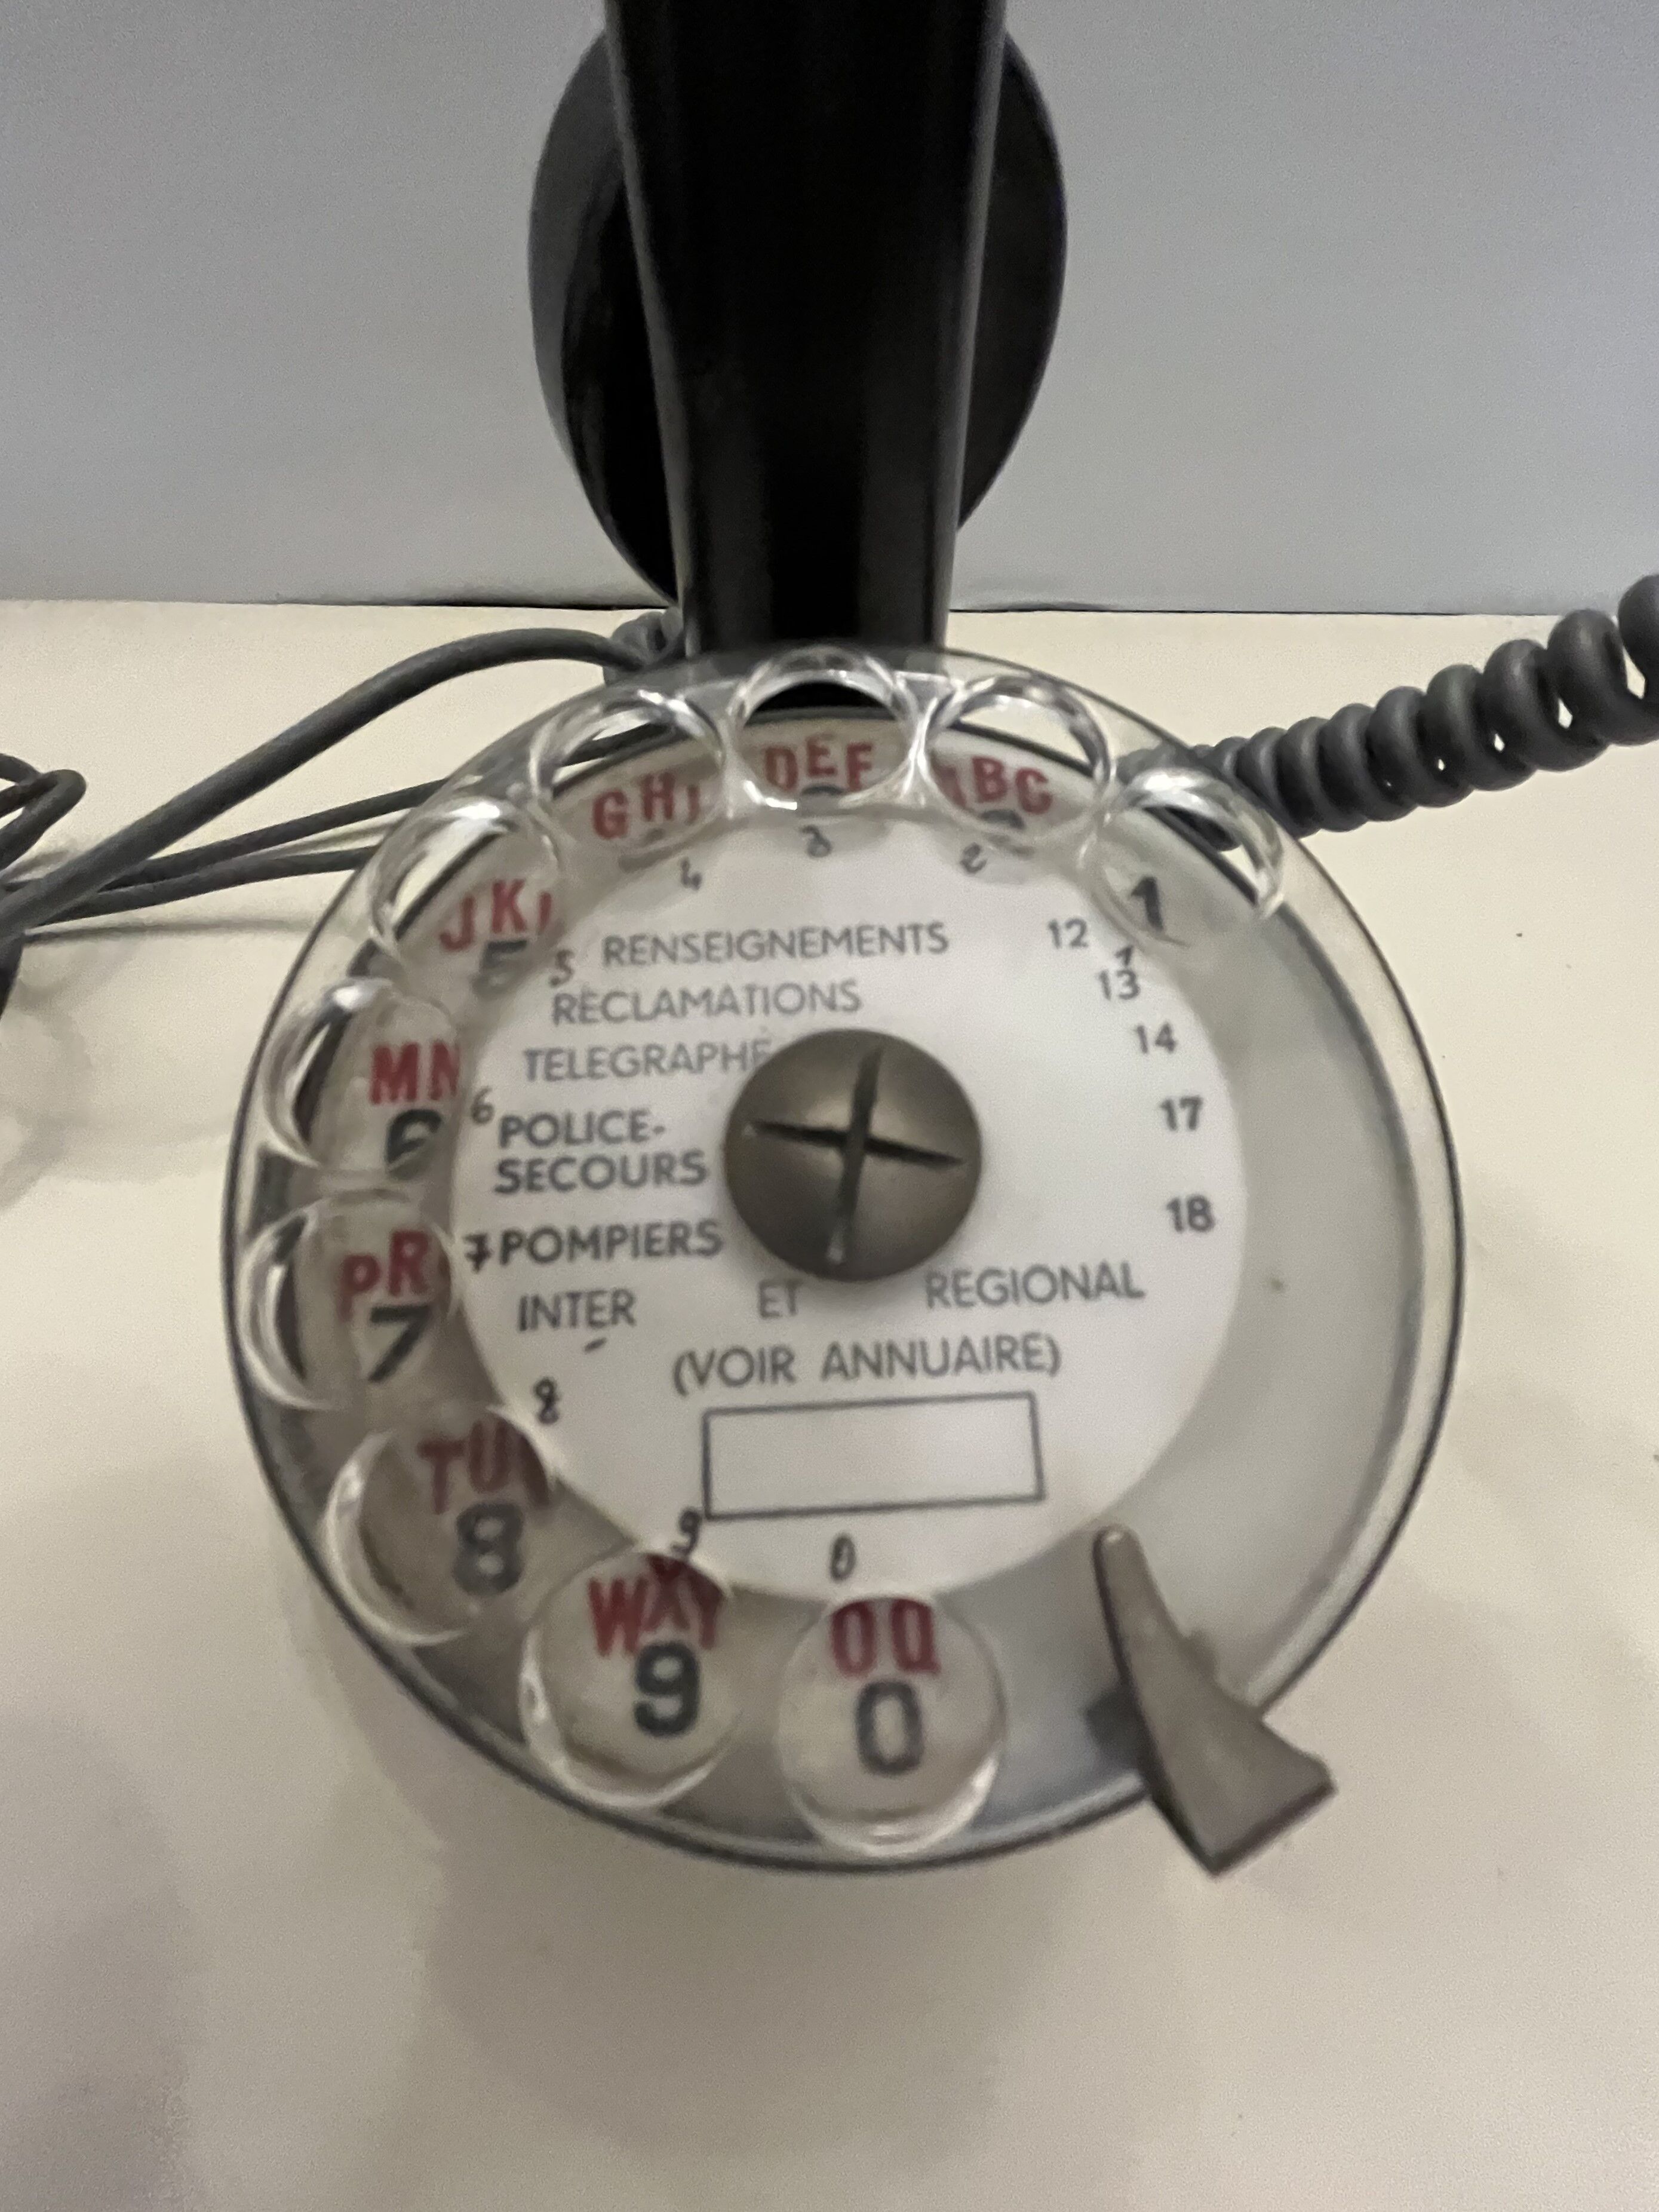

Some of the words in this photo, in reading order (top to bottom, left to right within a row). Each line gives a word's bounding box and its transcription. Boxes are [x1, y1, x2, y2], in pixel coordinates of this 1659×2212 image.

[1130, 876, 1165, 933] 1
[602, 921, 950, 969] RENSEIGNEMENTS
[1048, 919, 1089, 950] 12
[552, 978, 862, 1027] RECLAMATIONS
[1098, 968, 1142, 1001] 13
[1136, 1023, 1176, 1056] 14
[471, 1086, 494, 1127] 6
[1161, 1095, 1203, 1132] 17
[494, 1148, 707, 1195] SECOURS
[499, 1219, 725, 1266] POMPIERS
[1167, 1195, 1214, 1233] 18
[518, 1288, 637, 1333] INTER
[759, 1280, 803, 1315] ET
[925, 1262, 1145, 1308] REGIONAL
[367, 1303, 432, 1383] 7
[672, 1341, 797, 1397] (VOIR
[821, 1331, 1061, 1380] ANNUAIRE)
[534, 1376, 560, 1425] 8
[454, 1501, 524, 1597] 8
[633, 1640, 701, 1738] 9
[855, 1680, 926, 1778] 0
